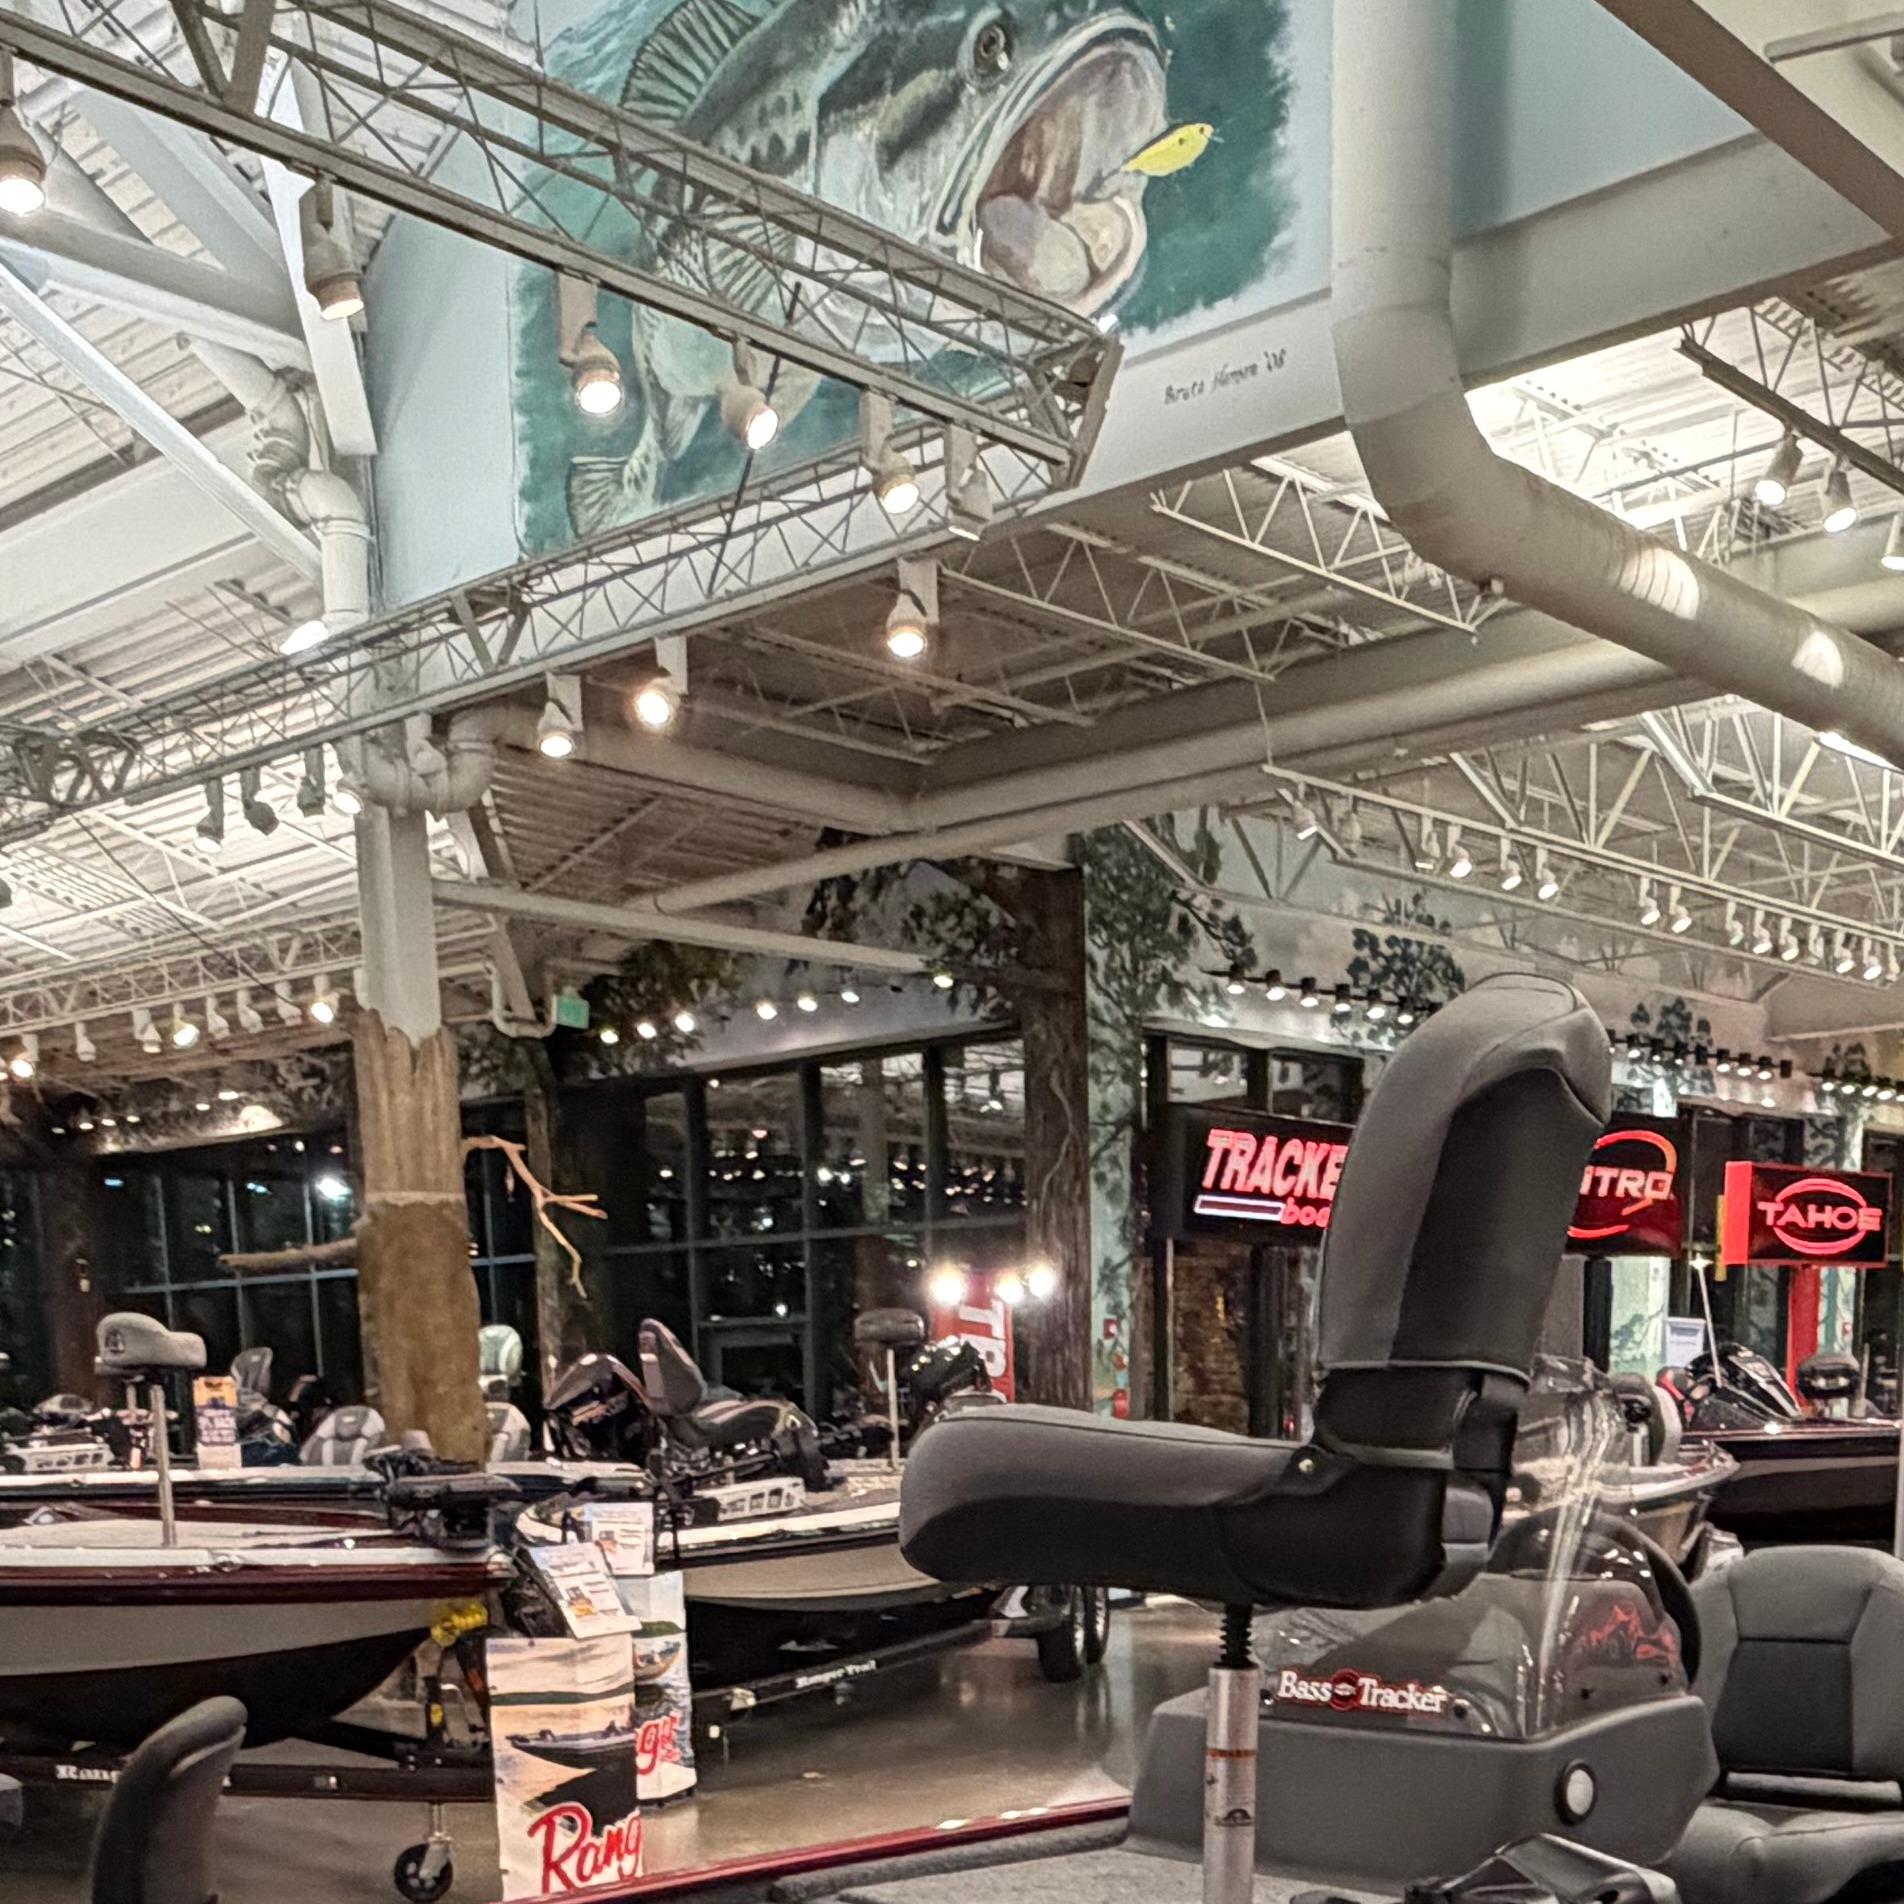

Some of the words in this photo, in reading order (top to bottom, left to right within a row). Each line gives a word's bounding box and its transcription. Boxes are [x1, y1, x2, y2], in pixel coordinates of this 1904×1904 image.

[1757, 1201, 1883, 1232] TAHOE
[1277, 1670, 1333, 1702] Bass
[1357, 1677, 1448, 1713] Tracker
